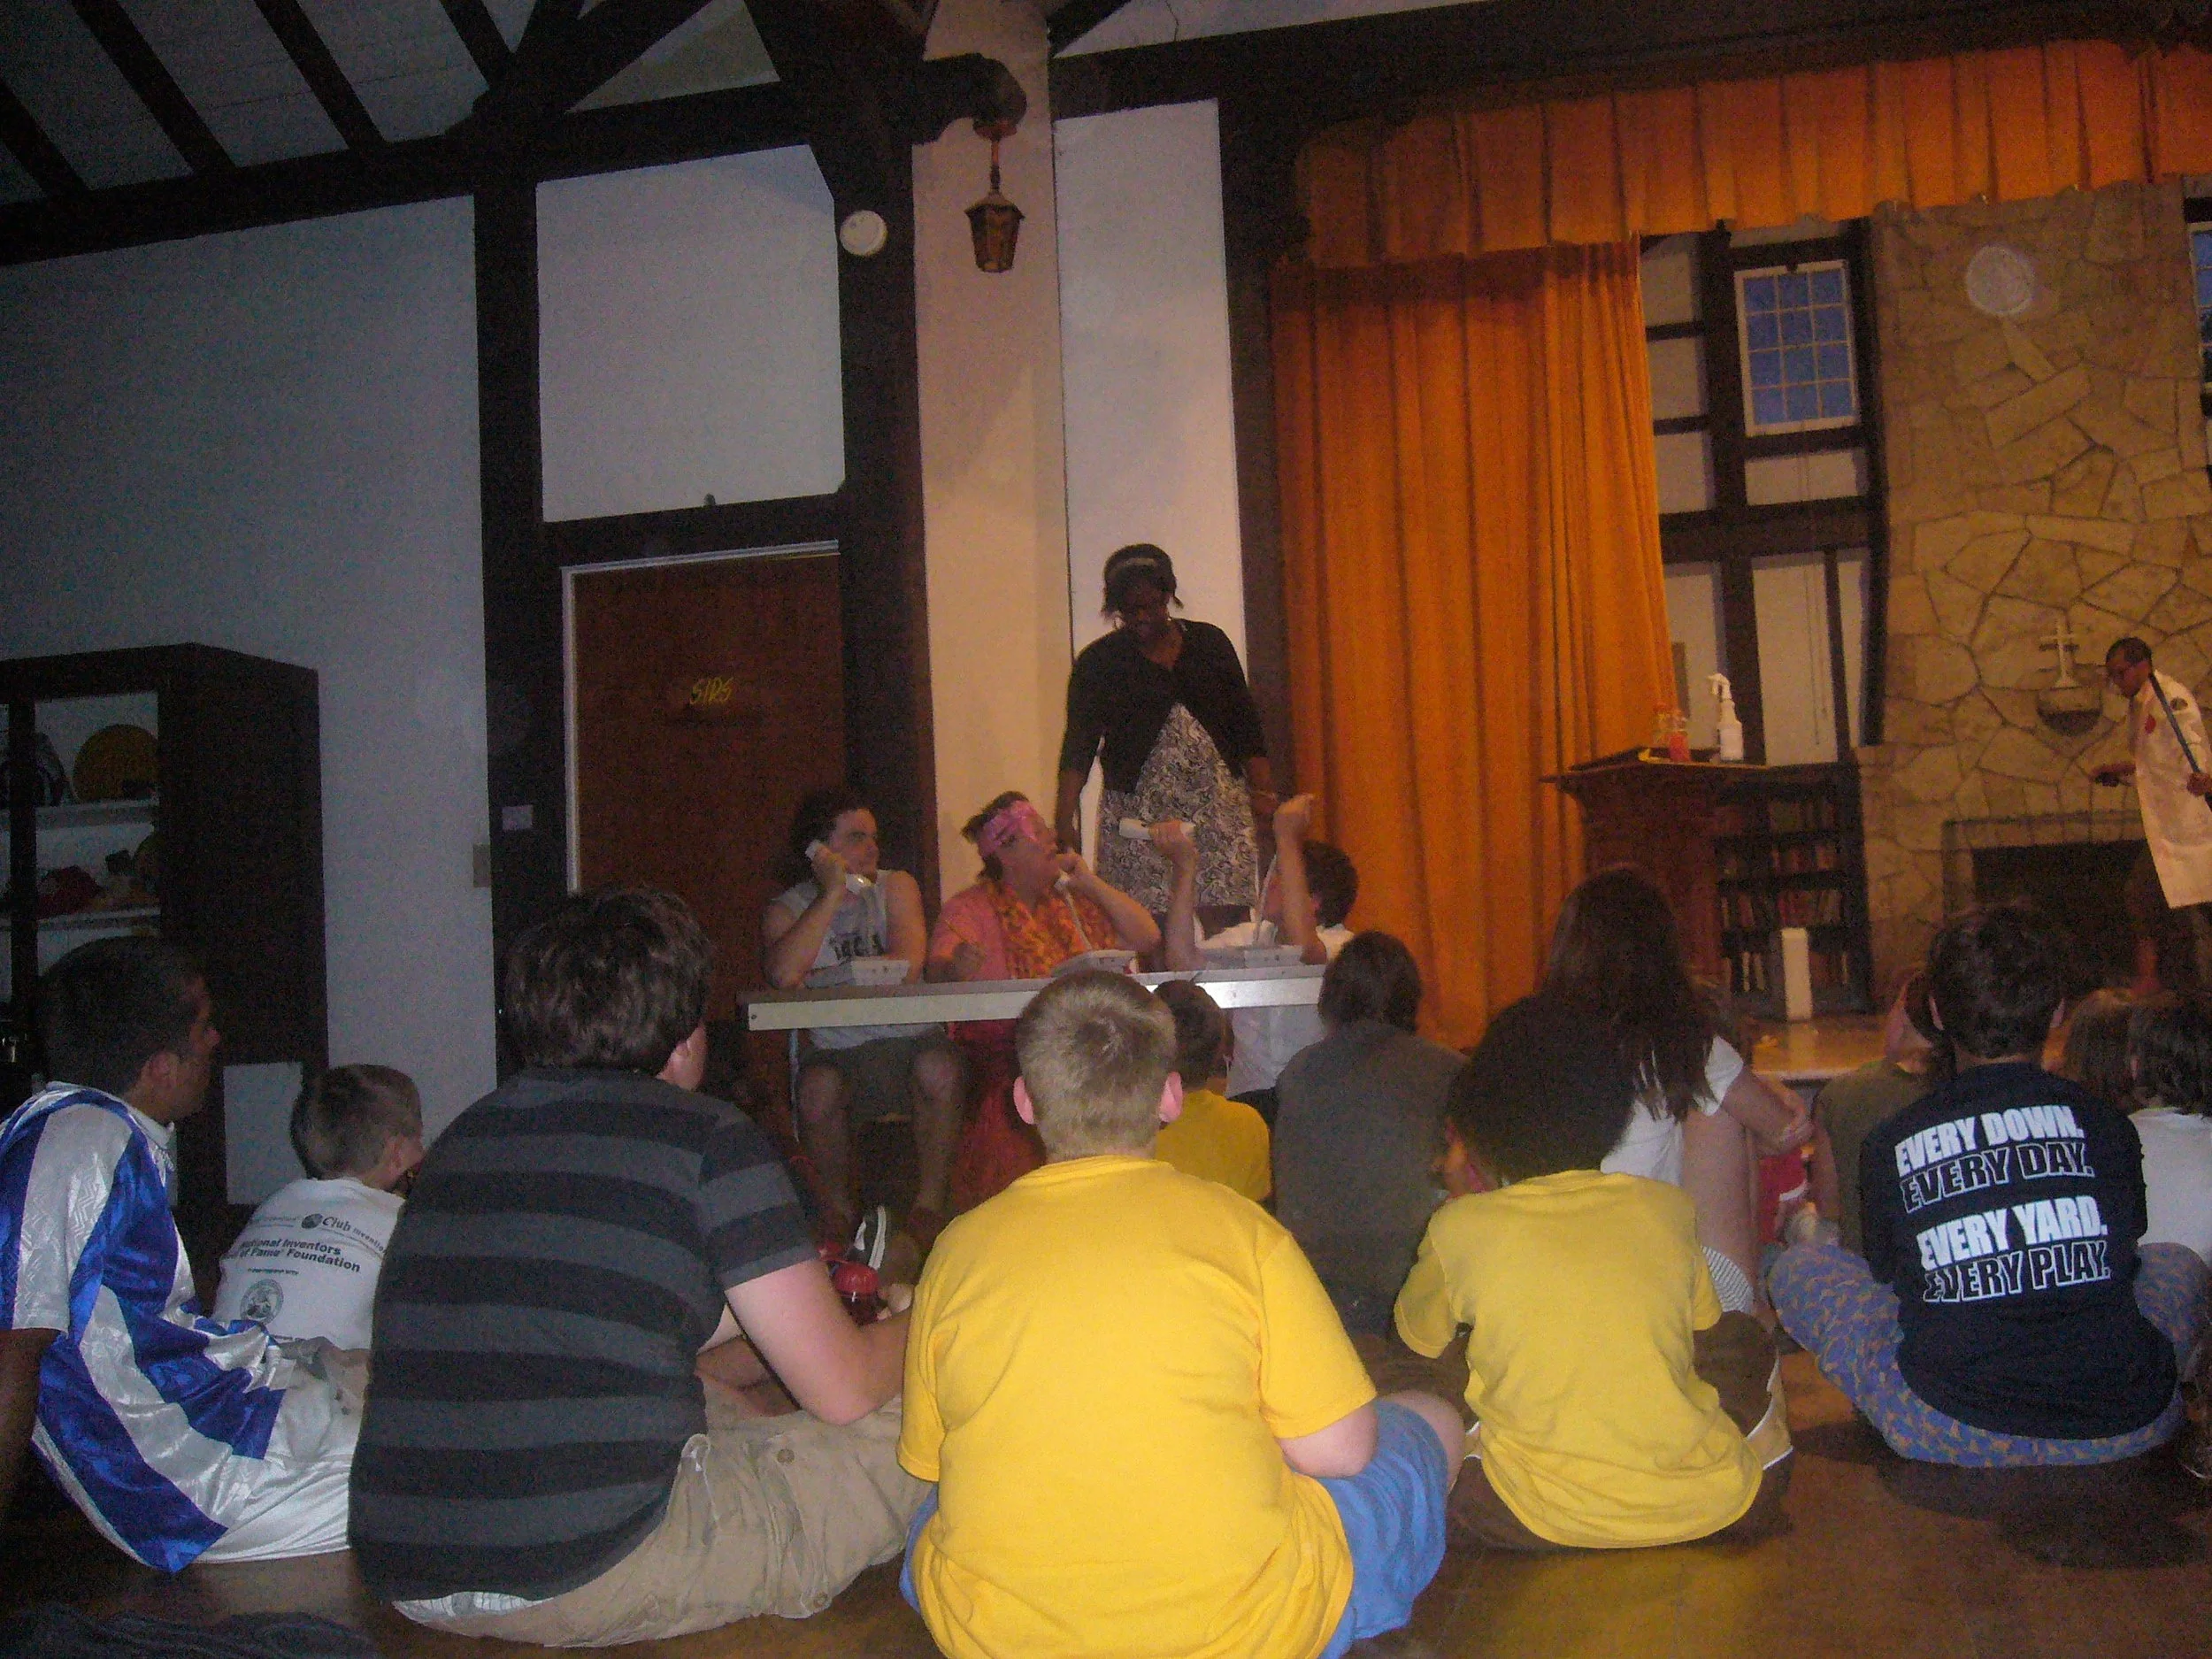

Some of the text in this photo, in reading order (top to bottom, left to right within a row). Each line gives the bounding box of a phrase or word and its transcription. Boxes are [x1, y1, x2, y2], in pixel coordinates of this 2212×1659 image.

[1894, 1105, 2085, 1177] EVERY DOWN.
[1900, 1142, 2095, 1213] EVERY DAY.
[282, 1239, 342, 1255] Inventors
[322, 1216, 351, 1232] Club
[1916, 1195, 2108, 1271] EVERY YARD.
[287, 1248, 361, 1272] Foundation
[1923, 1240, 2111, 1302] EVERY PLAY.
